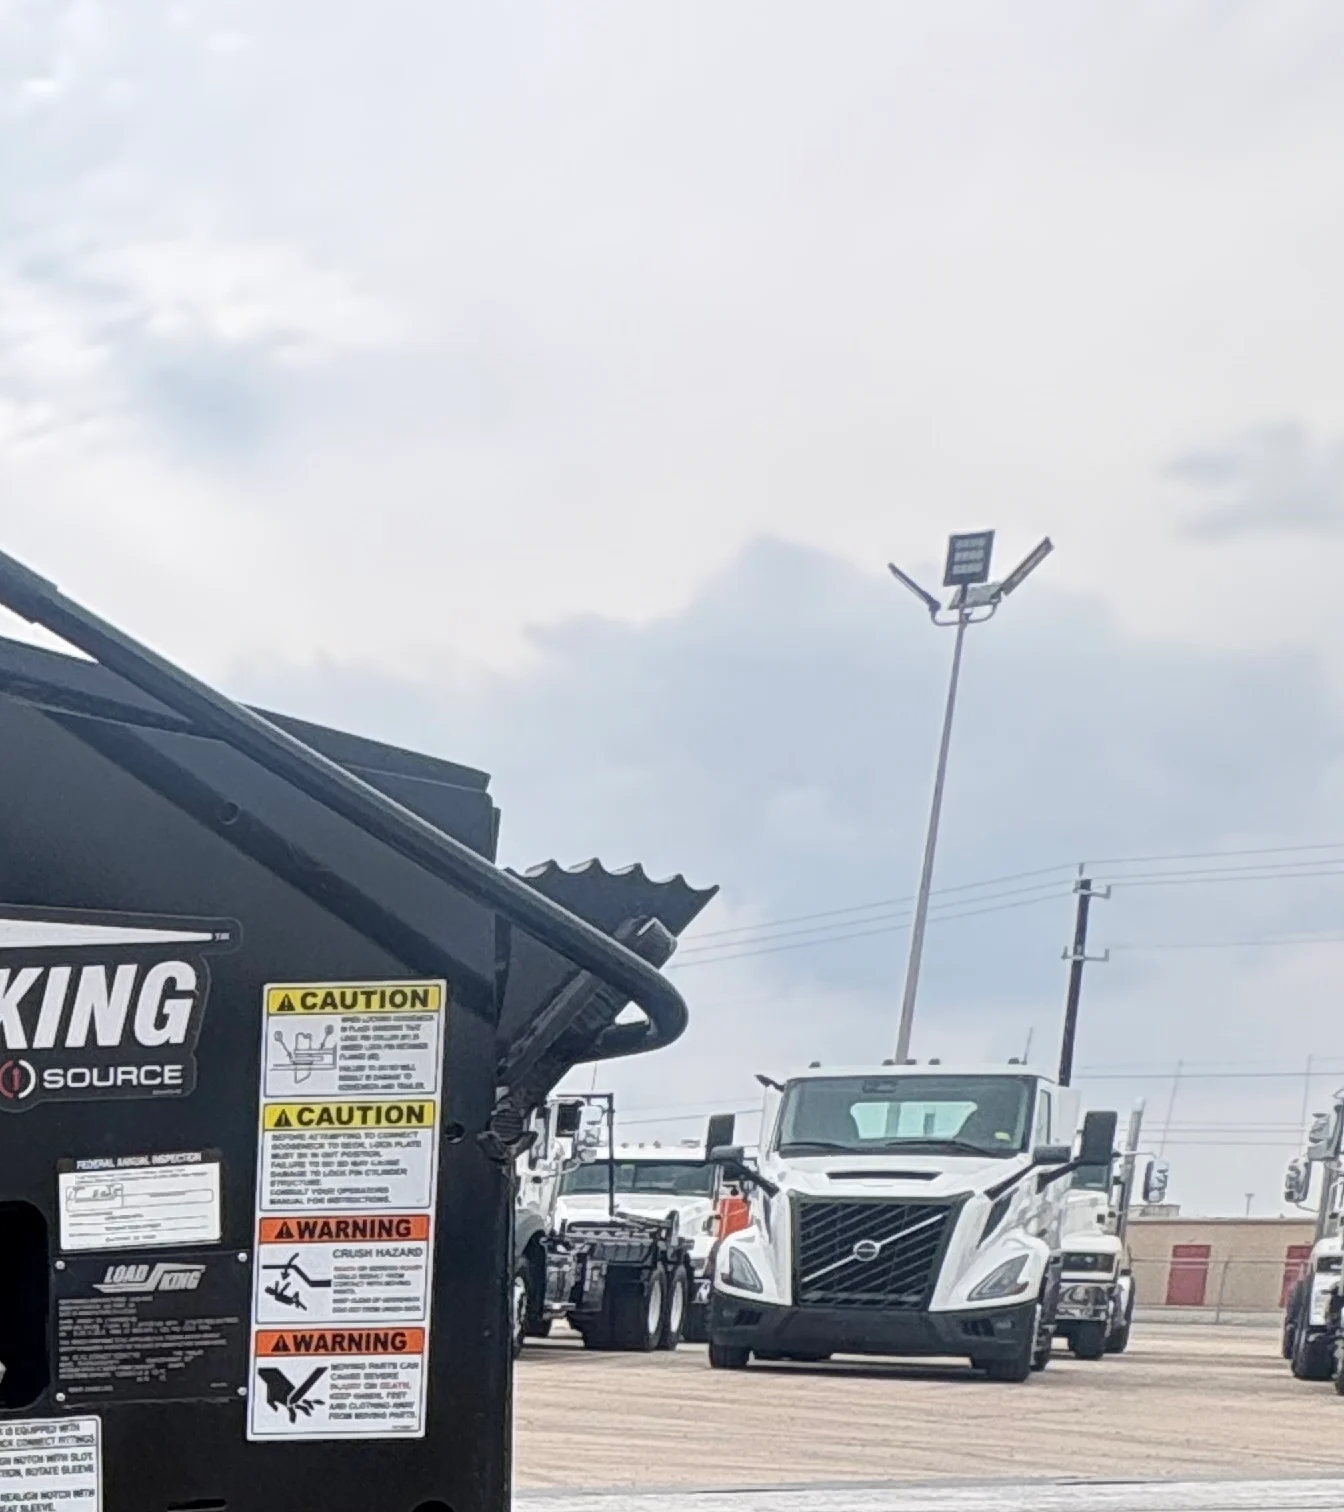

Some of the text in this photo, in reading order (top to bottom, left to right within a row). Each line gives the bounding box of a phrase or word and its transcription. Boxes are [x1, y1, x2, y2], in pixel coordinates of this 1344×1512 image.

[301, 989, 429, 1010] CAUTION
[43, 1065, 182, 1088] SOURCE
[297, 1105, 424, 1125] CAUTION
[296, 1219, 411, 1238] WARNING
[333, 1247, 422, 1258] CRUSH HAZARD
[104, 1265, 201, 1290] LOAD KING
[293, 1333, 406, 1351] WARNING
[15, 1425, 56, 1435] EQUIPPED
[59, 1424, 80, 1433] WITH
[16, 1437, 55, 1447] CONNECT
[14, 1455, 43, 1464] NOTCH
[47, 1453, 68, 1462] WITH
